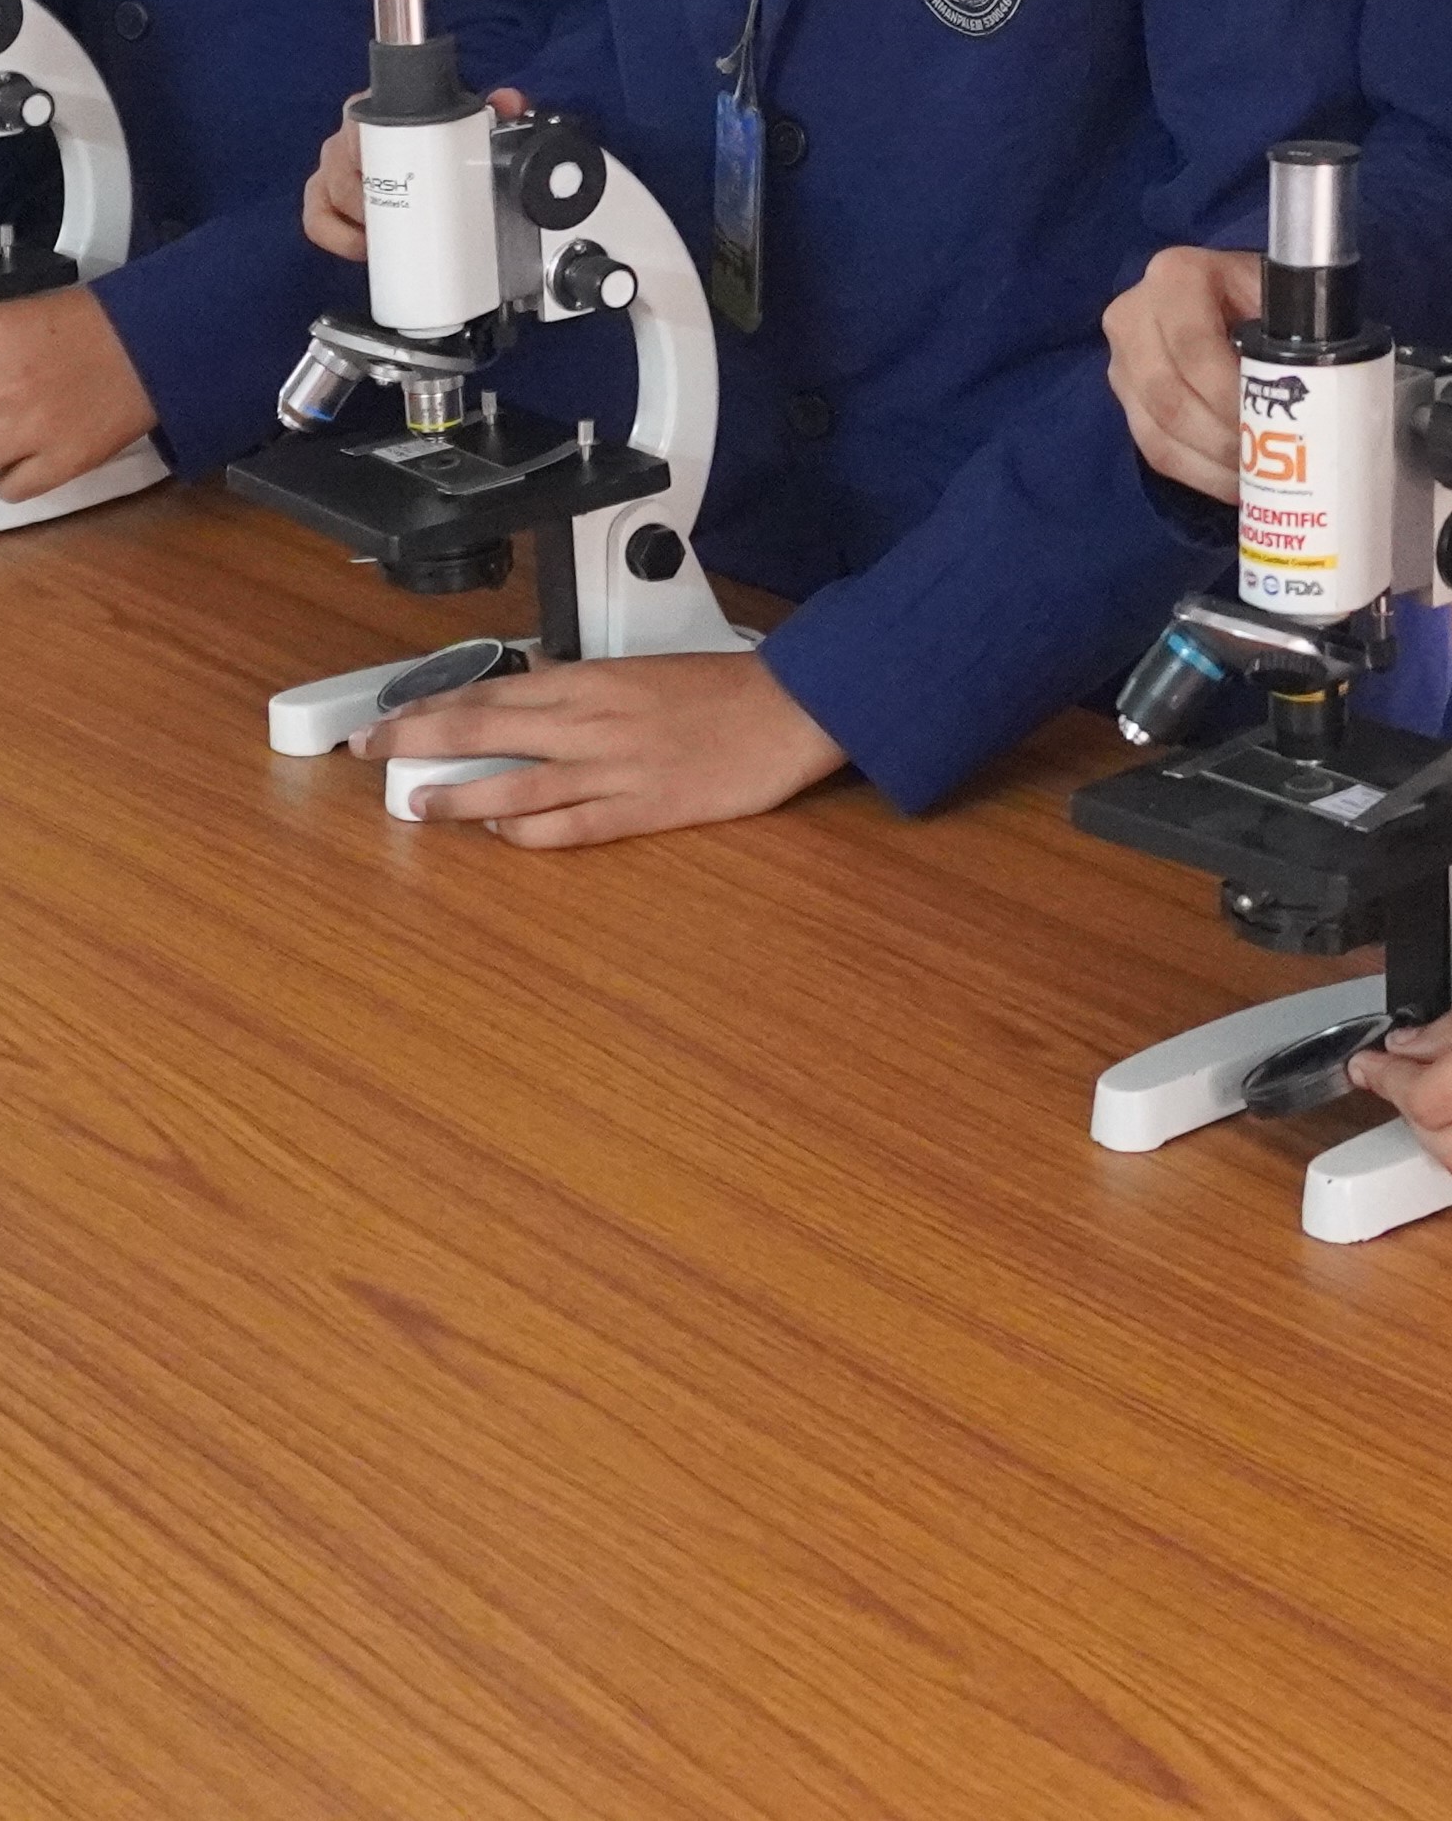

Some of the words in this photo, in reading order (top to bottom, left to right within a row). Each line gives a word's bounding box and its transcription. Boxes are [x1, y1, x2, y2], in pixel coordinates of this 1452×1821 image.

[362, 174, 409, 192] ARSH
[1247, 503, 1328, 529] SCIENTIFIC
[1285, 580, 1324, 596] FDA
